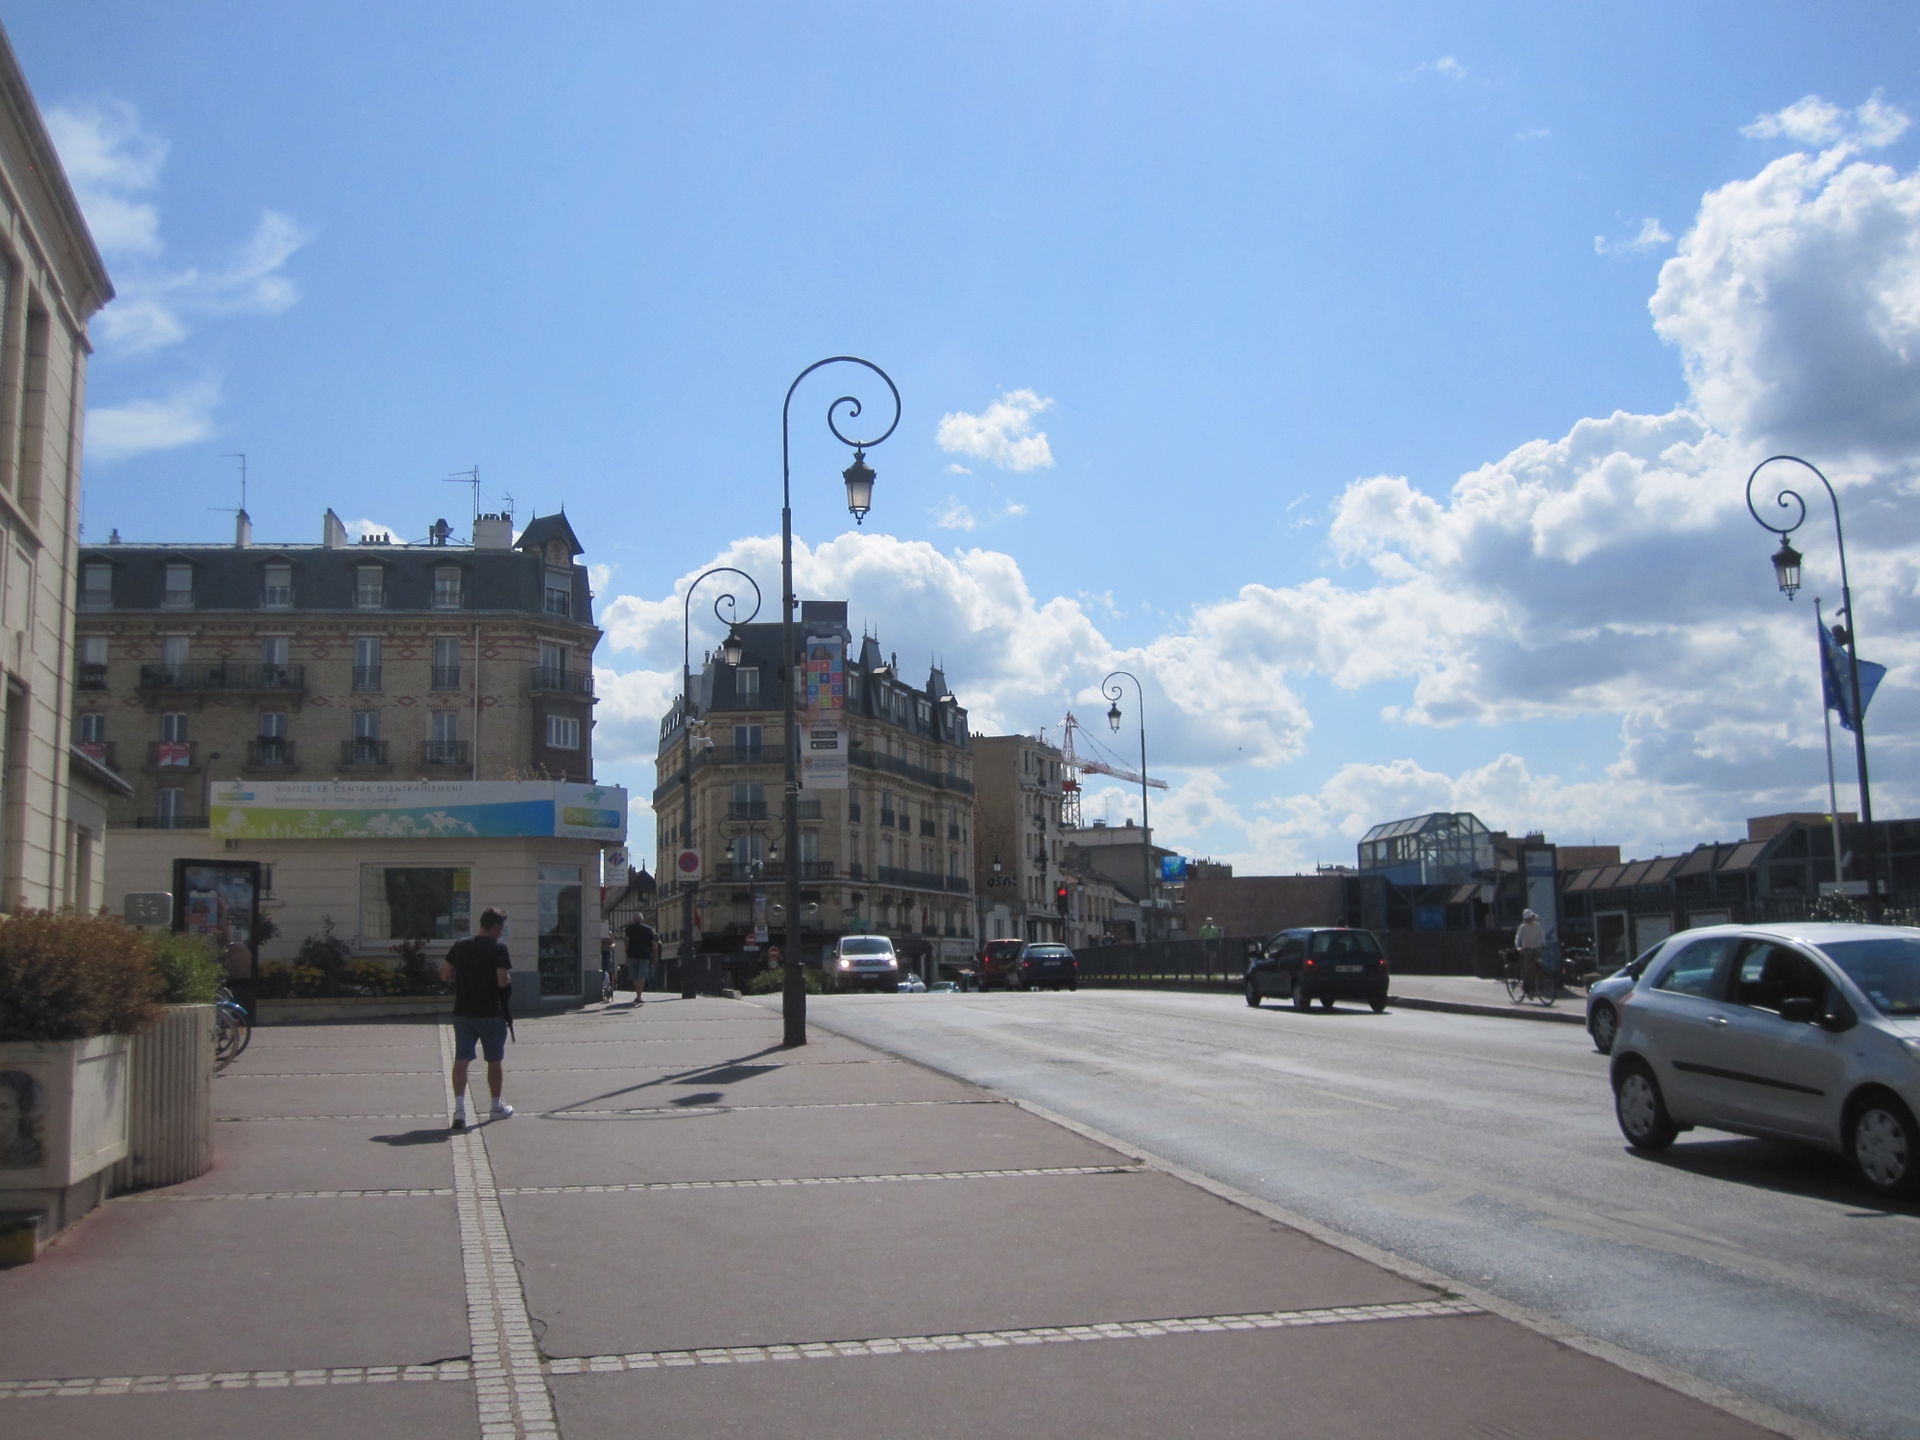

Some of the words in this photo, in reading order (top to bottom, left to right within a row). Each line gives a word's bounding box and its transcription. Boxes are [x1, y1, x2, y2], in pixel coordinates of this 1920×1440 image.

[276, 785, 312, 793] VISITEZ
[318, 785, 329, 793] LE
[334, 785, 371, 793] CENTRE
